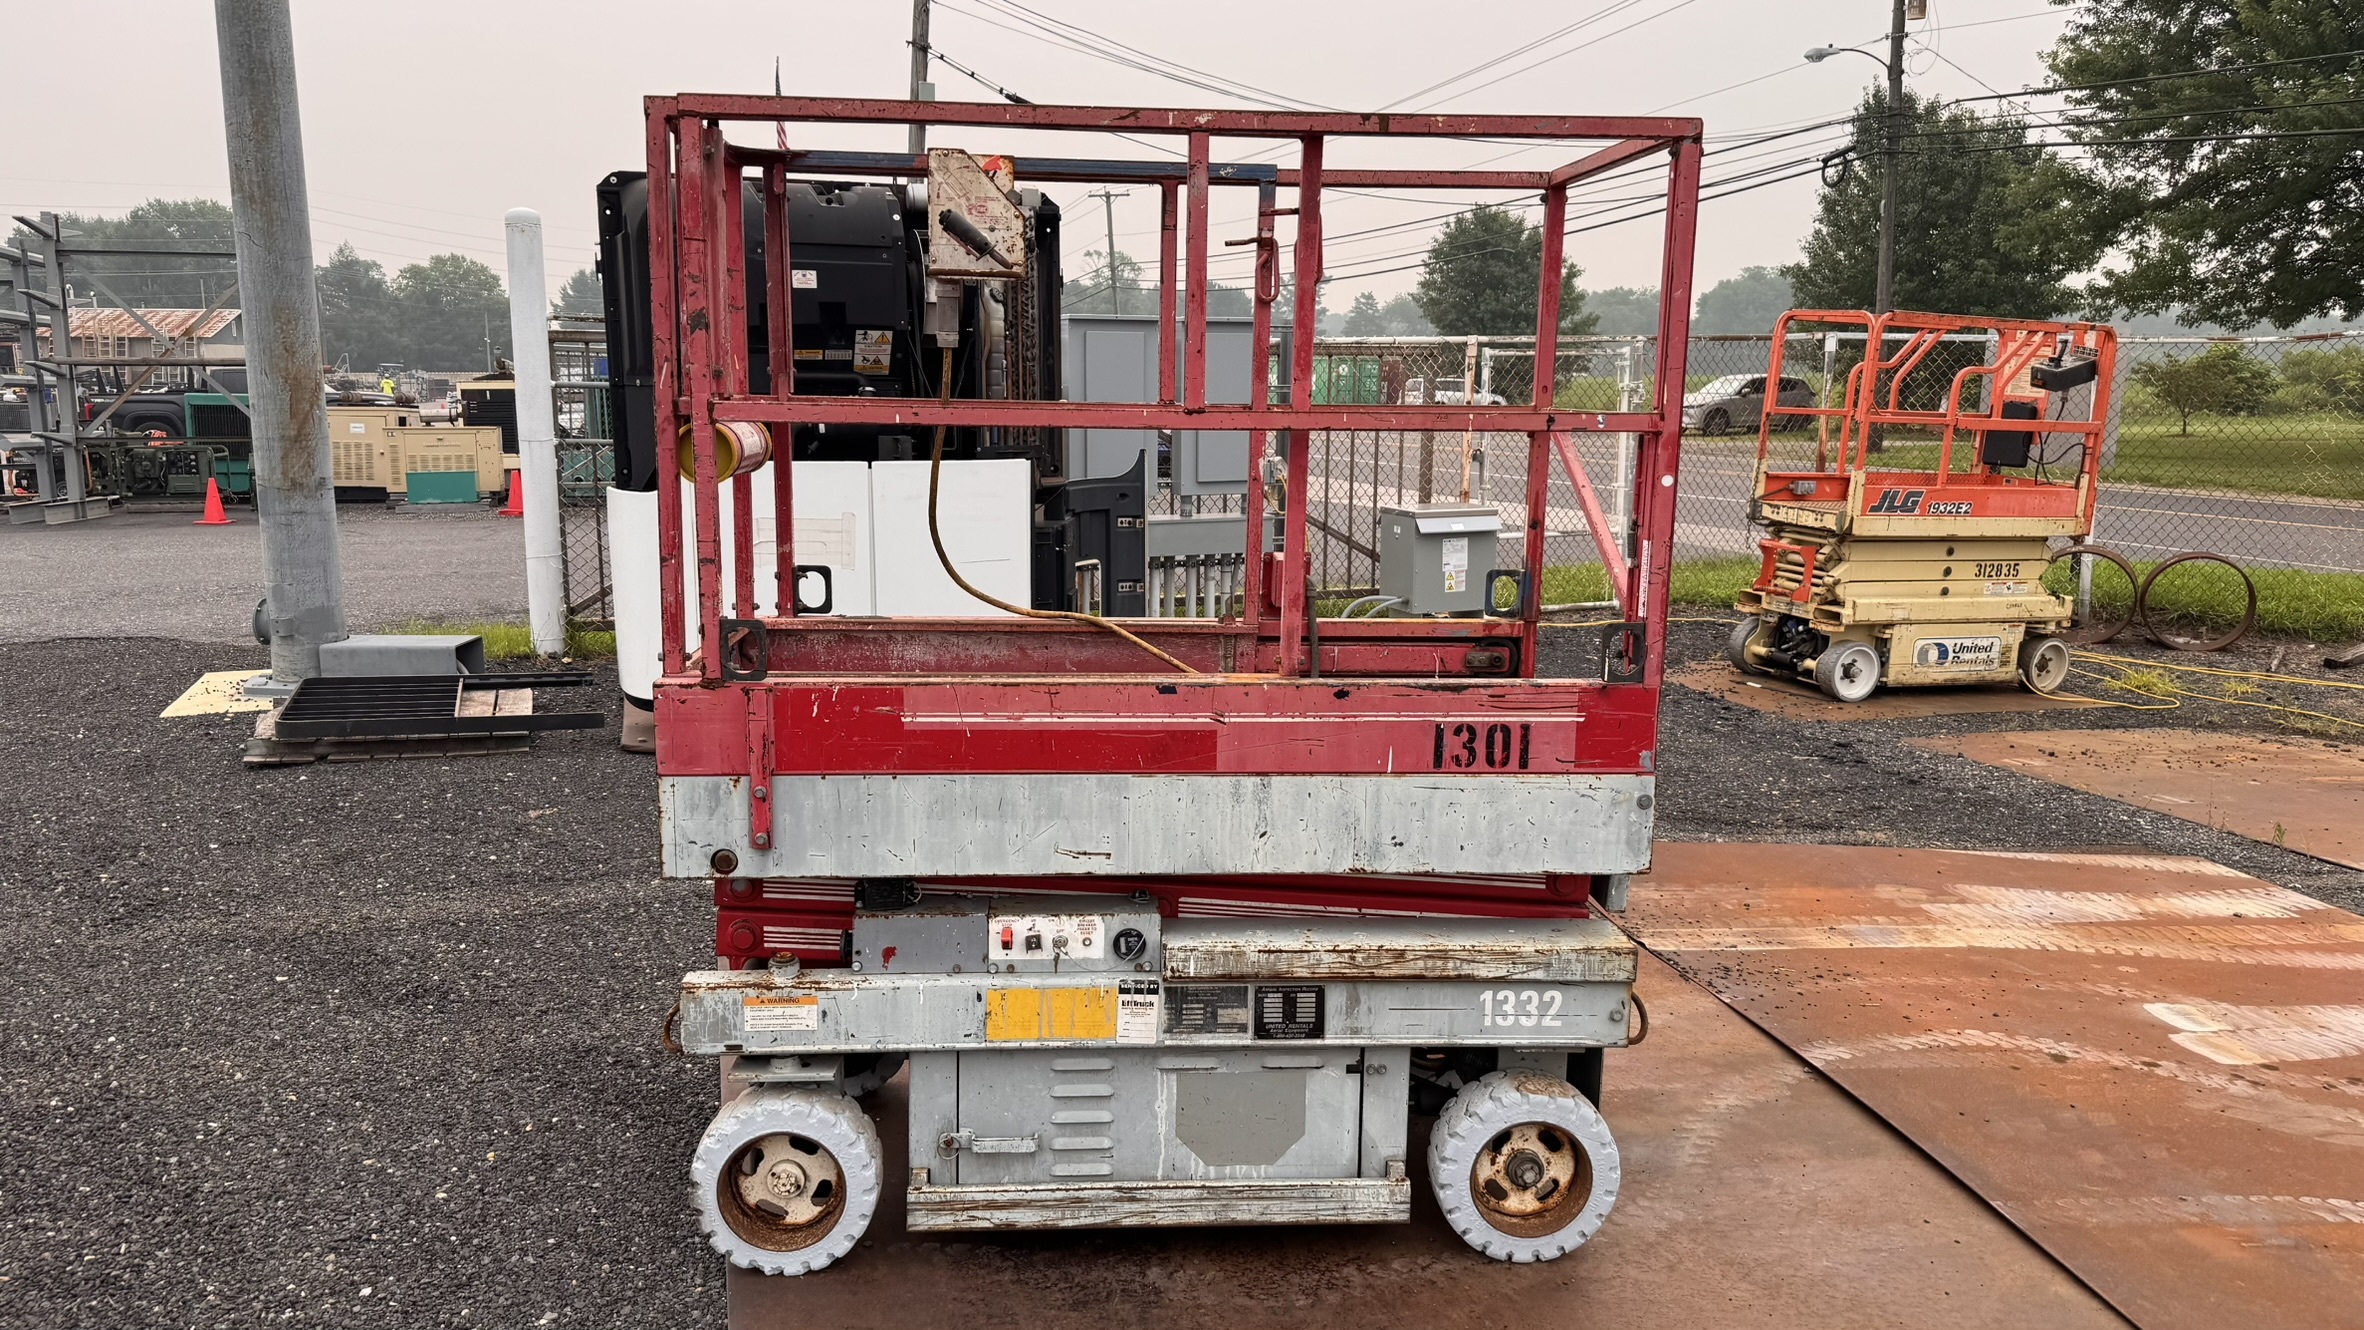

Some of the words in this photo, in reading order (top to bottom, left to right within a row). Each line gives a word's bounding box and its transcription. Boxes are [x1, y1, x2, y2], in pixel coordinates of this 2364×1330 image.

[1867, 489, 1925, 514] JLG
[1926, 502, 1973, 514] 1932E2
[1974, 562, 2020, 578] 312835
[1952, 641, 1994, 654] United
[1433, 723, 1530, 769] 1301
[1479, 989, 1563, 1027] 1332
